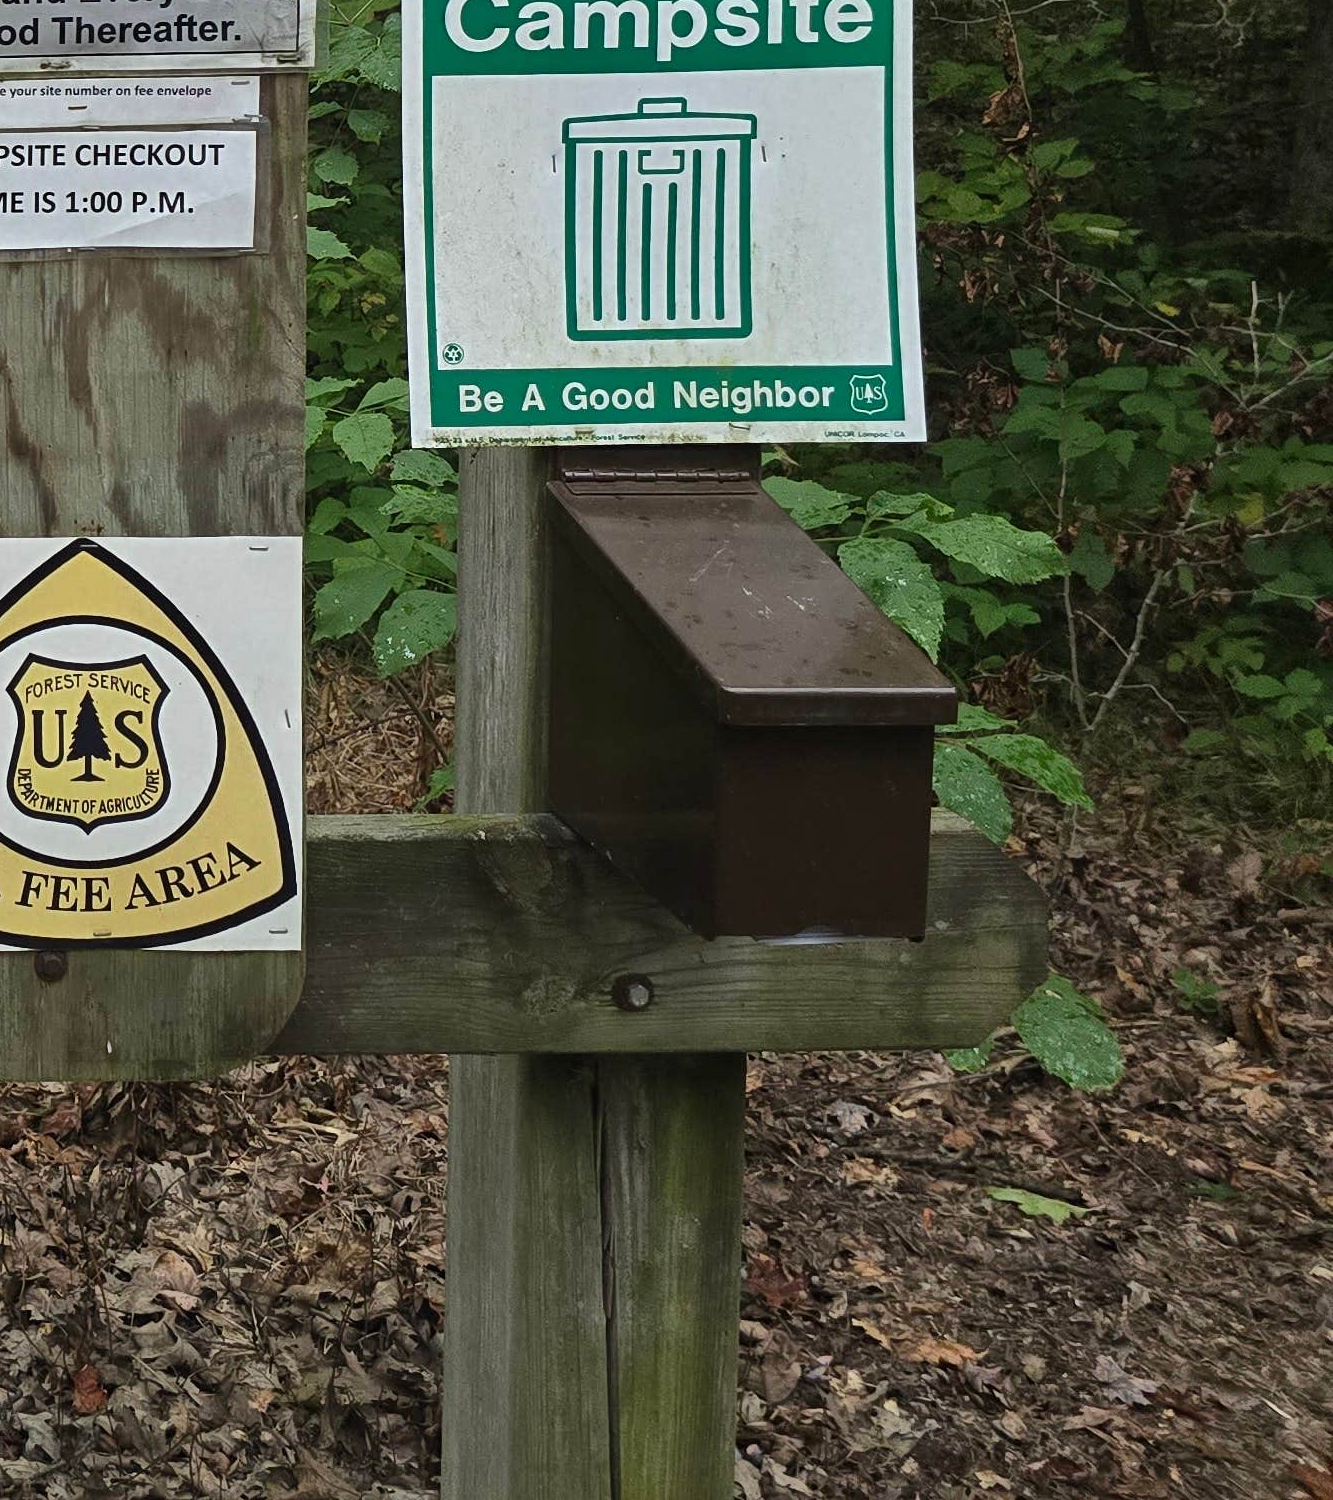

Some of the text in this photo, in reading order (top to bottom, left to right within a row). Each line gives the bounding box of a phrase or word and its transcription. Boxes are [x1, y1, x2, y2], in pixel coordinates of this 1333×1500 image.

[9, 87, 37, 99] your
[40, 85, 62, 96] site
[64, 85, 112, 96] number
[115, 87, 131, 96] on
[134, 85, 154, 96] fee
[157, 84, 212, 99] envelope
[75, 144, 225, 166] CHECKOUT
[34, 192, 56, 214] IS
[65, 192, 123, 213] 1:00
[132, 192, 194, 213] P.M.
[459, 380, 835, 413] Be A Good Neighbor
[15, 871, 111, 911] FEE
[124, 841, 261, 910] AREA
